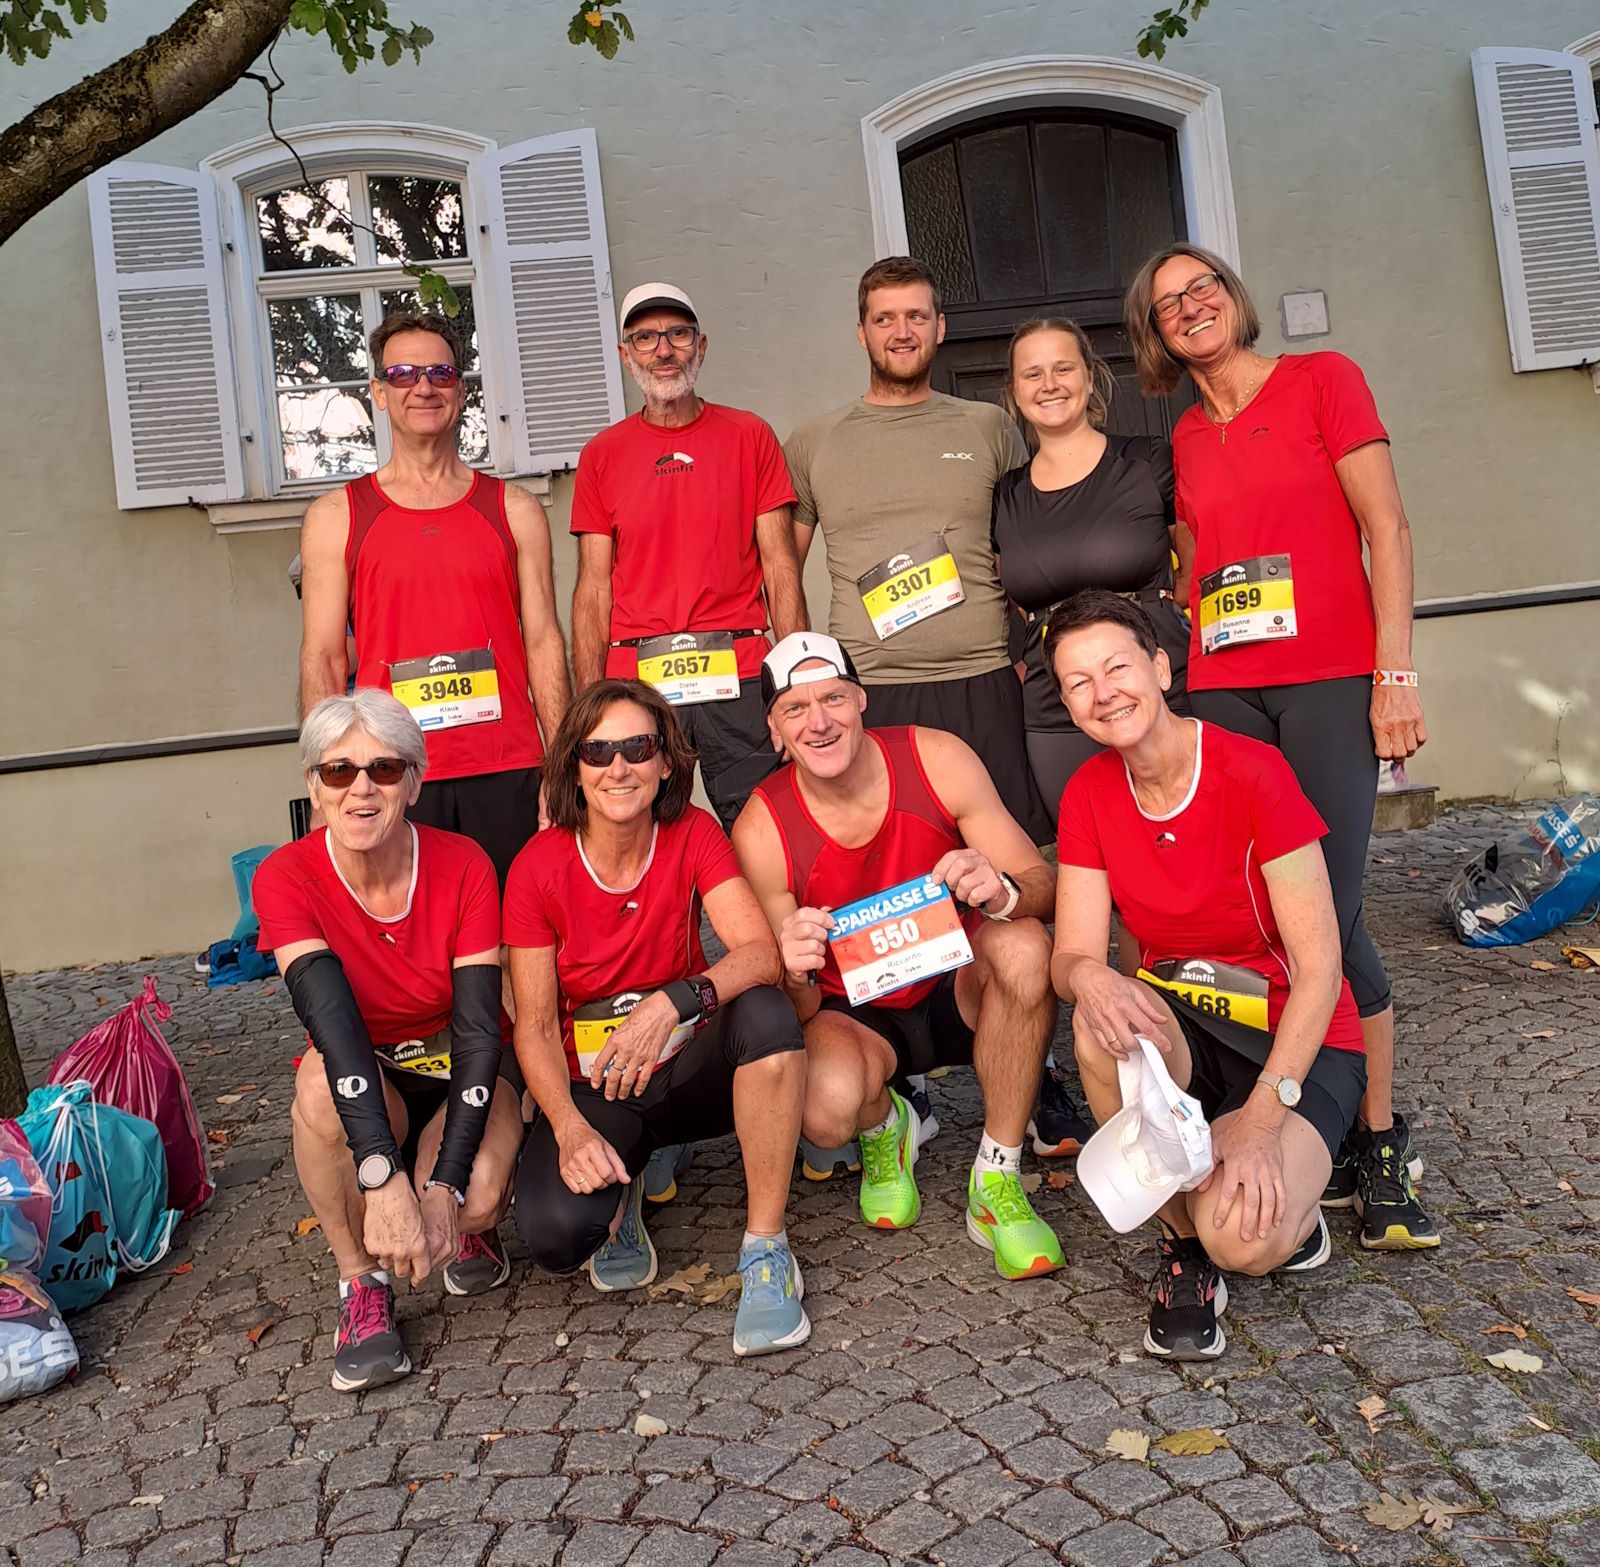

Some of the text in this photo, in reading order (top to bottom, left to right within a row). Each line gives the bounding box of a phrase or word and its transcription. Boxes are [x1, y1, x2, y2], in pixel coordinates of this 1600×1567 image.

[655, 464, 694, 477] skinfit
[889, 559, 914, 575] skinfit
[885, 567, 932, 602] 3307
[1221, 573, 1247, 586] skinfit
[1214, 587, 1262, 617] 1699
[1222, 619, 1251, 629] Susanne
[671, 641, 697, 651] skinfit
[429, 664, 457, 674] skinfit
[661, 655, 710, 678] 2657
[419, 677, 473, 702] 3948
[832, 886, 924, 937] SPARKASSE
[869, 917, 920, 956] 550
[887, 951, 922, 969] Riccardo
[877, 978, 900, 991] skinfit
[1181, 971, 1216, 984] skinfit
[613, 1002, 640, 1015] skin
[1170, 988, 1231, 1019] 168
[393, 1047, 426, 1061] skinfit
[406, 1059, 448, 1073] 53
[46, 1254, 106, 1283] skin
